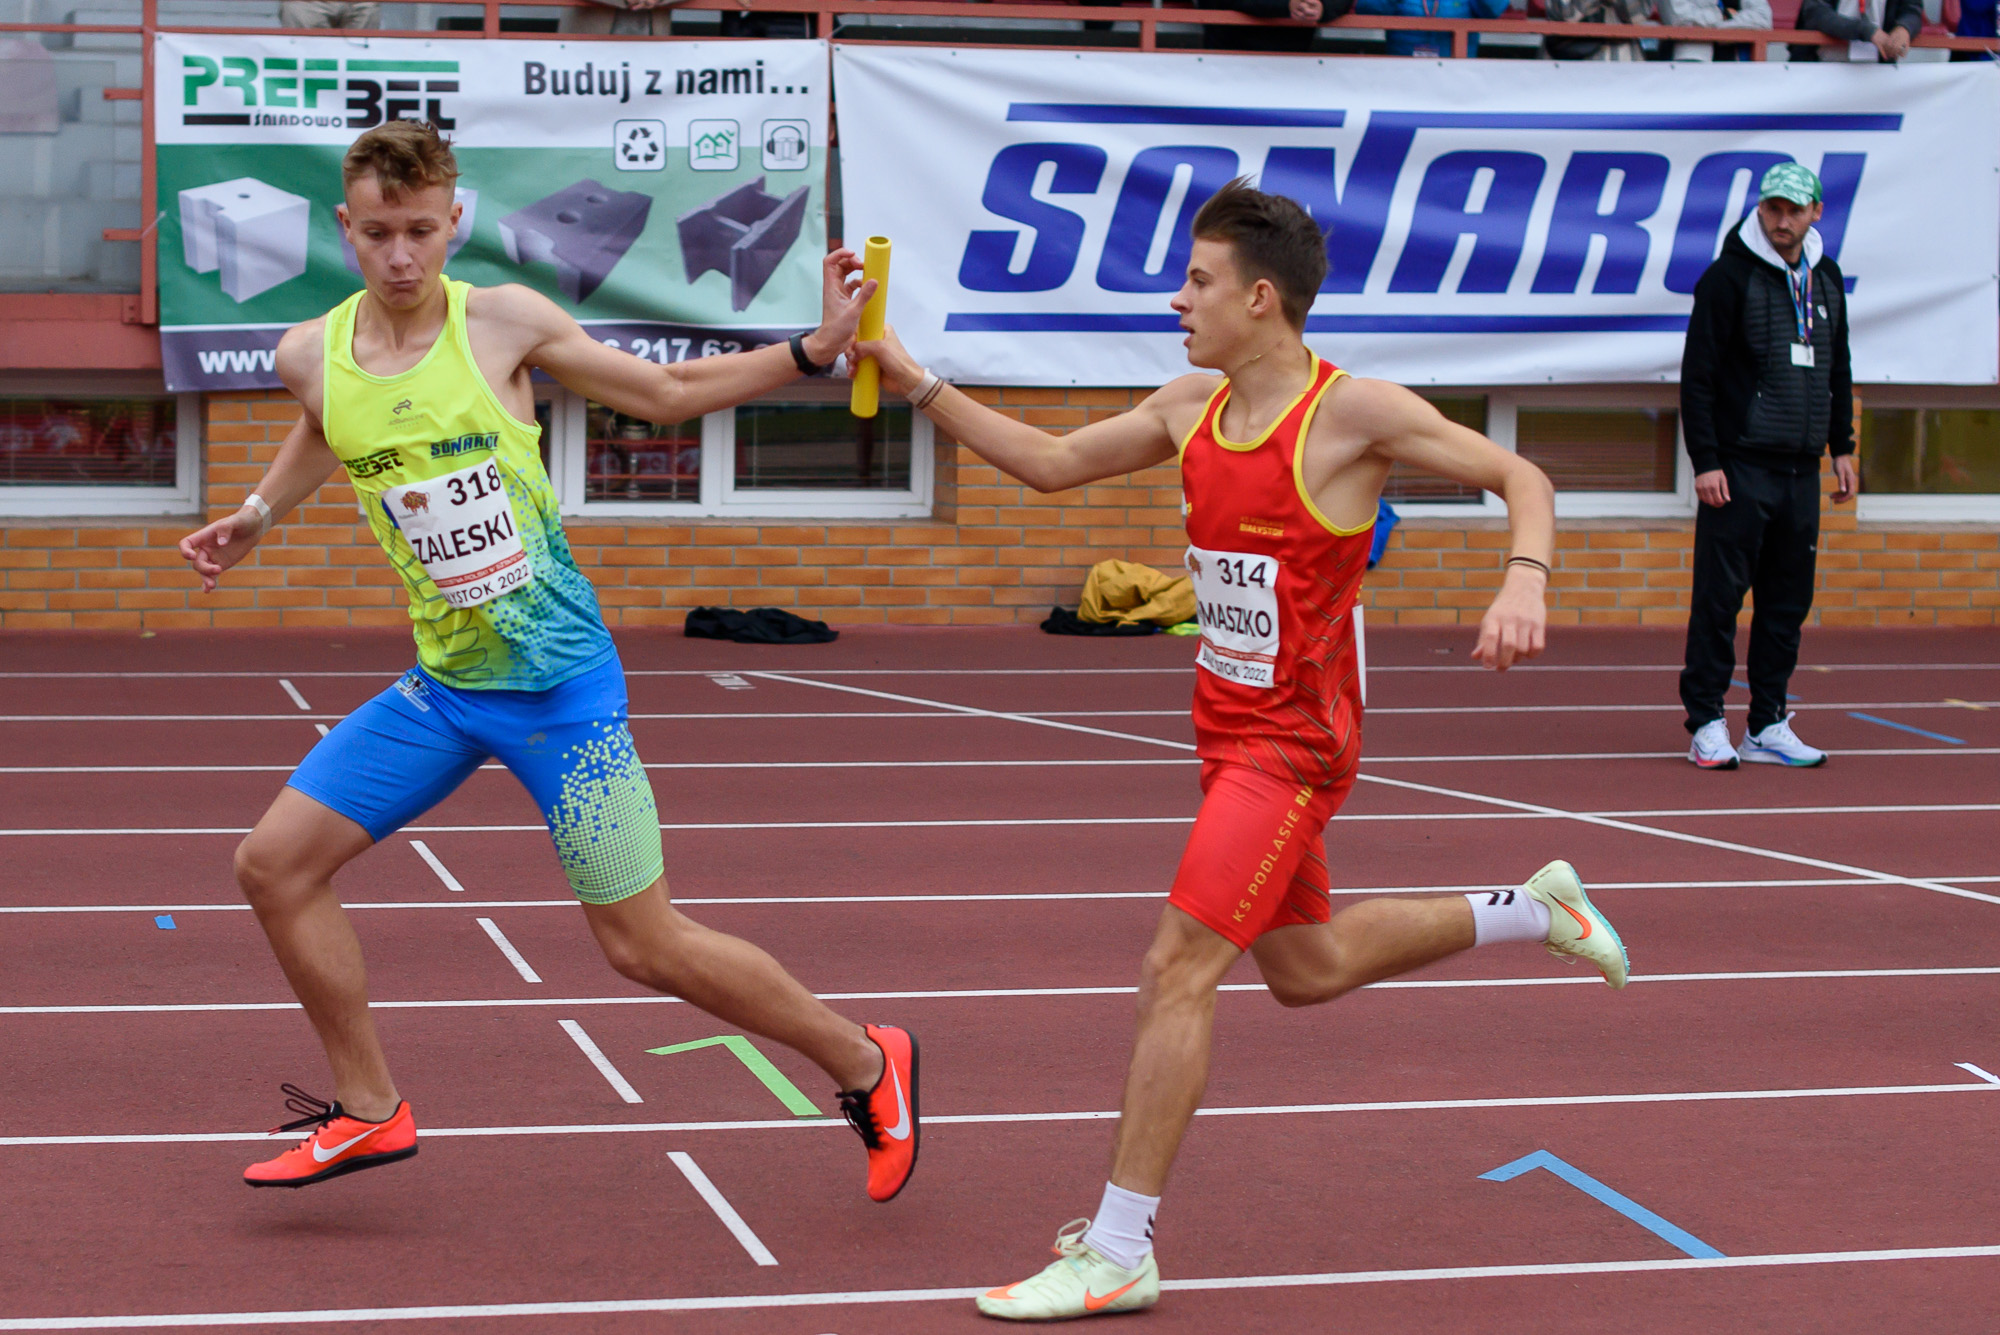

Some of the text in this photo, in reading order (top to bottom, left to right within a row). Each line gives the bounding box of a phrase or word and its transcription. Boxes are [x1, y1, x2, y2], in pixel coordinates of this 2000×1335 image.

[524, 60, 808, 103] Buduj z nami...
[958, 111, 1868, 295] SONAROL
[630, 338, 692, 365] 217
[446, 464, 501, 506] 318
[411, 510, 514, 565] ZALESKI
[498, 564, 529, 589] 2022
[1217, 558, 1267, 588] 314
[1243, 666, 1267, 682] 2022
[1232, 899, 1252, 923] KS
[1248, 809, 1300, 896] PODLASIE
